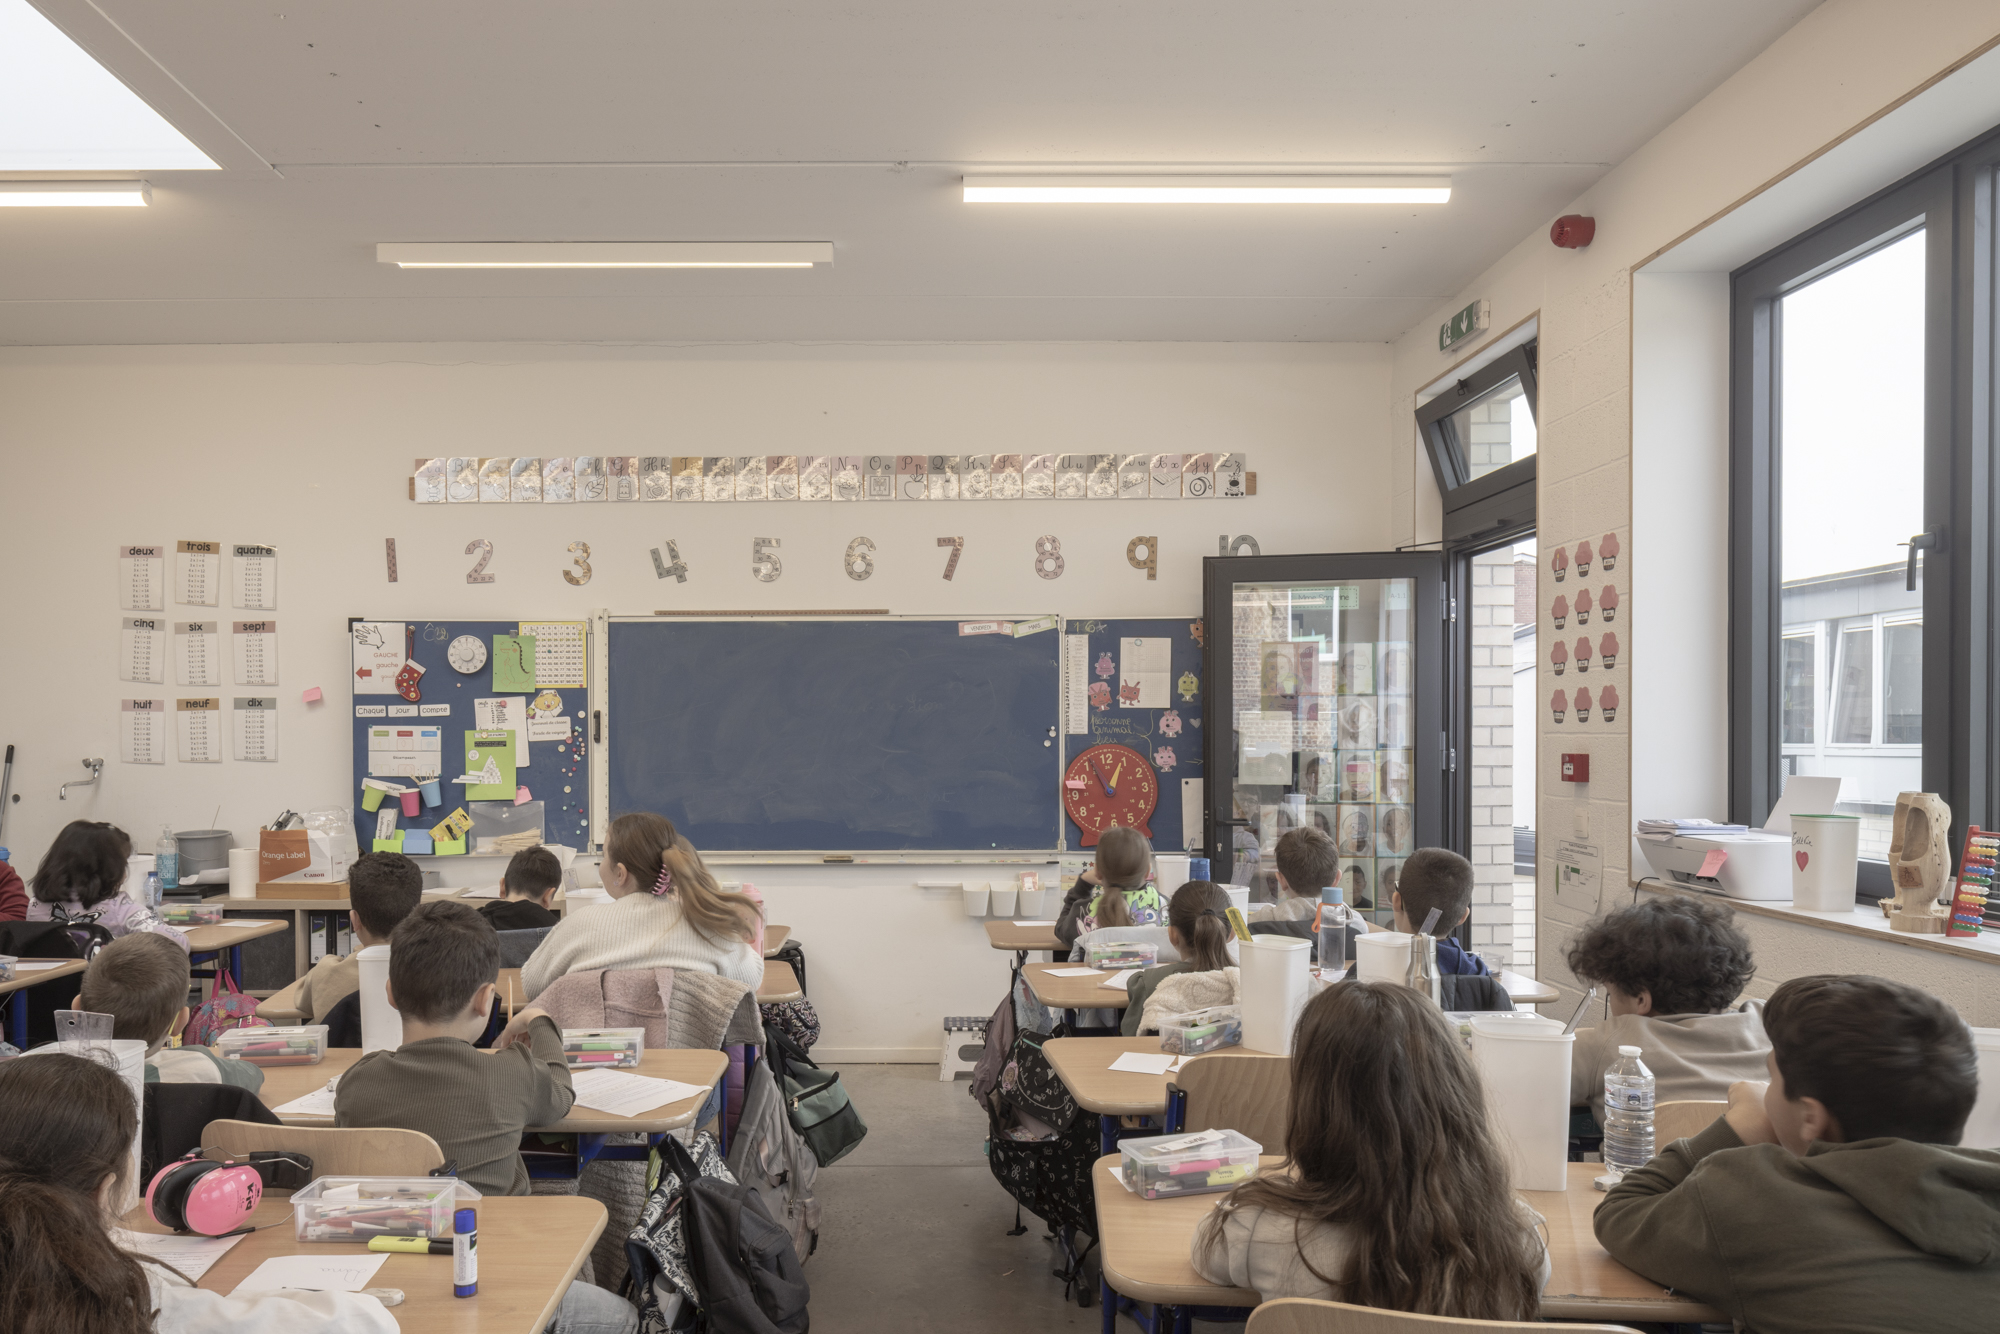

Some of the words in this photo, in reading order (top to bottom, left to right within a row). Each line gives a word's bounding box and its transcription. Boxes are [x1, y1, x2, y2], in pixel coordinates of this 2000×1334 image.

[644, 457, 657, 472] H
[835, 456, 849, 471] N
[870, 456, 882, 470] O
[902, 456, 913, 470] P
[964, 456, 978, 470] R
[129, 546, 154, 556] deux
[186, 541, 211, 552] trois
[236, 545, 272, 556] quatre
[386, 538, 398, 582] 1
[464, 539, 494, 584] 2
[562, 540, 592, 586] 3
[650, 539, 688, 584] 4
[752, 537, 782, 582] 5
[844, 536, 876, 581] 6
[937, 536, 964, 582] 7
[1035, 534, 1064, 580] 8
[1126, 536, 1158, 580] 9
[134, 618, 155, 630] cinq
[188, 622, 203, 632] six
[242, 622, 266, 633] sept
[133, 700, 152, 709] huit
[186, 699, 210, 709] neuf
[248, 698, 262, 707] dix
[357, 708, 384, 716] Chaque
[396, 706, 410, 714] jour
[1100, 754, 1113, 764] 12
[1121, 757, 1126, 766] 1
[1136, 768, 1142, 778] 2
[1074, 774, 1088, 784] 10
[1142, 782, 1148, 792] 3
[1072, 790, 1079, 800] 9
[1138, 800, 1146, 809] 4
[1080, 806, 1087, 816] 8
[1094, 817, 1100, 827] 7
[1127, 813, 1134, 823] 5
[1110, 819, 1118, 828] 6
[262, 851, 284, 860] Orange
